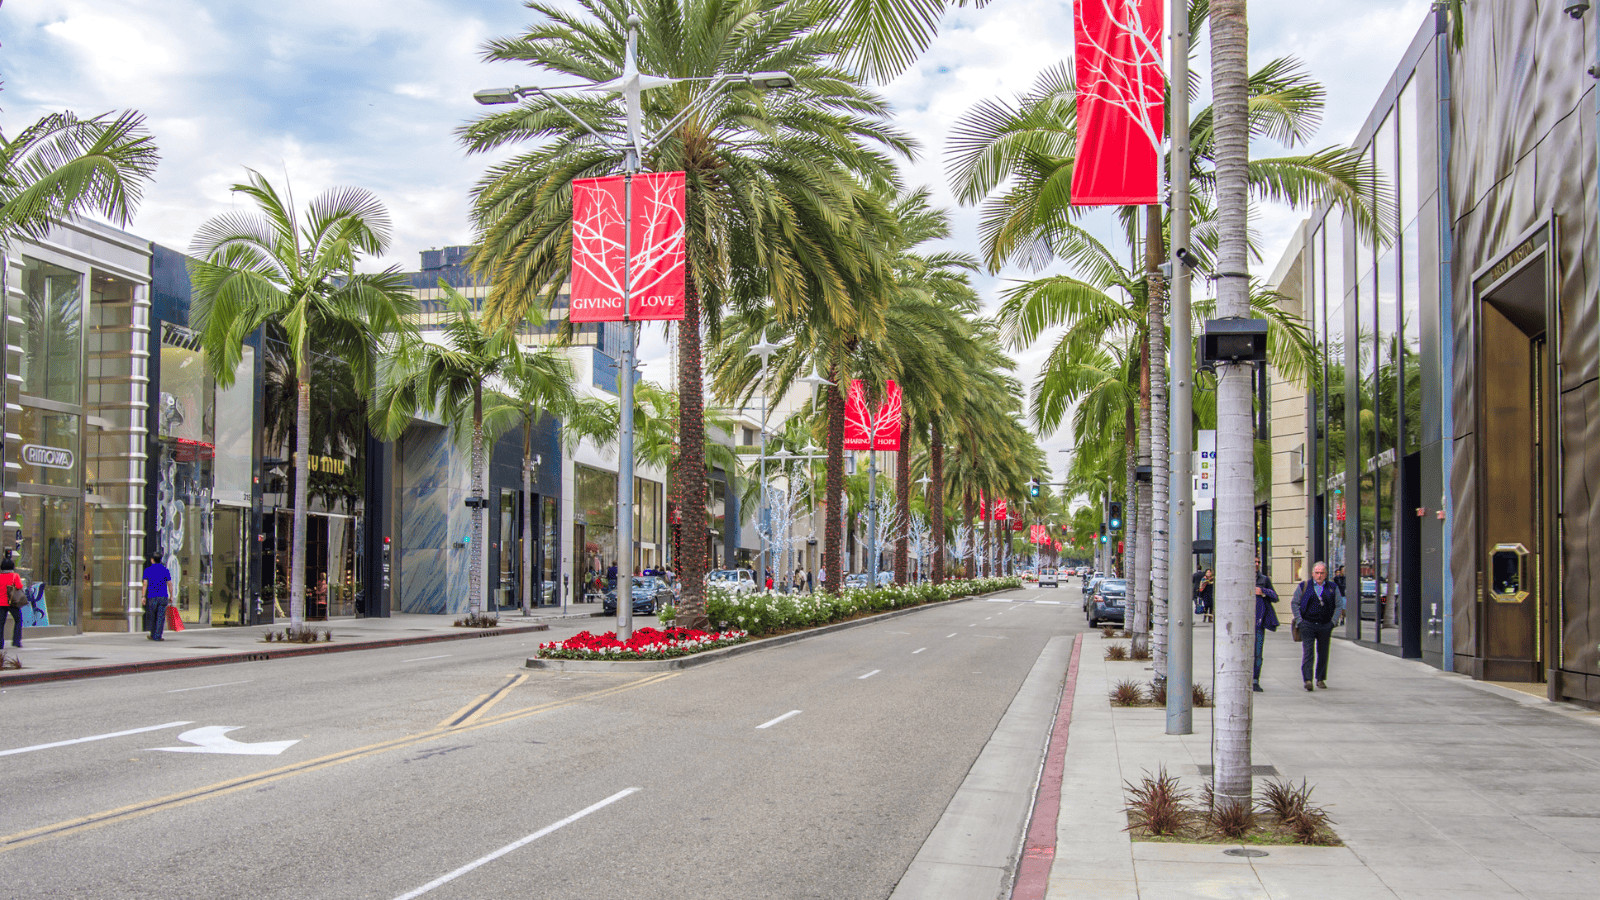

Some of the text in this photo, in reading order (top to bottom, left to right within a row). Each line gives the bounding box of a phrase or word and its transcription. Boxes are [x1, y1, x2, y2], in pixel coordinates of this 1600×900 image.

[573, 295, 674, 309] GIVING LOVE
[28, 447, 69, 466] RIMOWA
